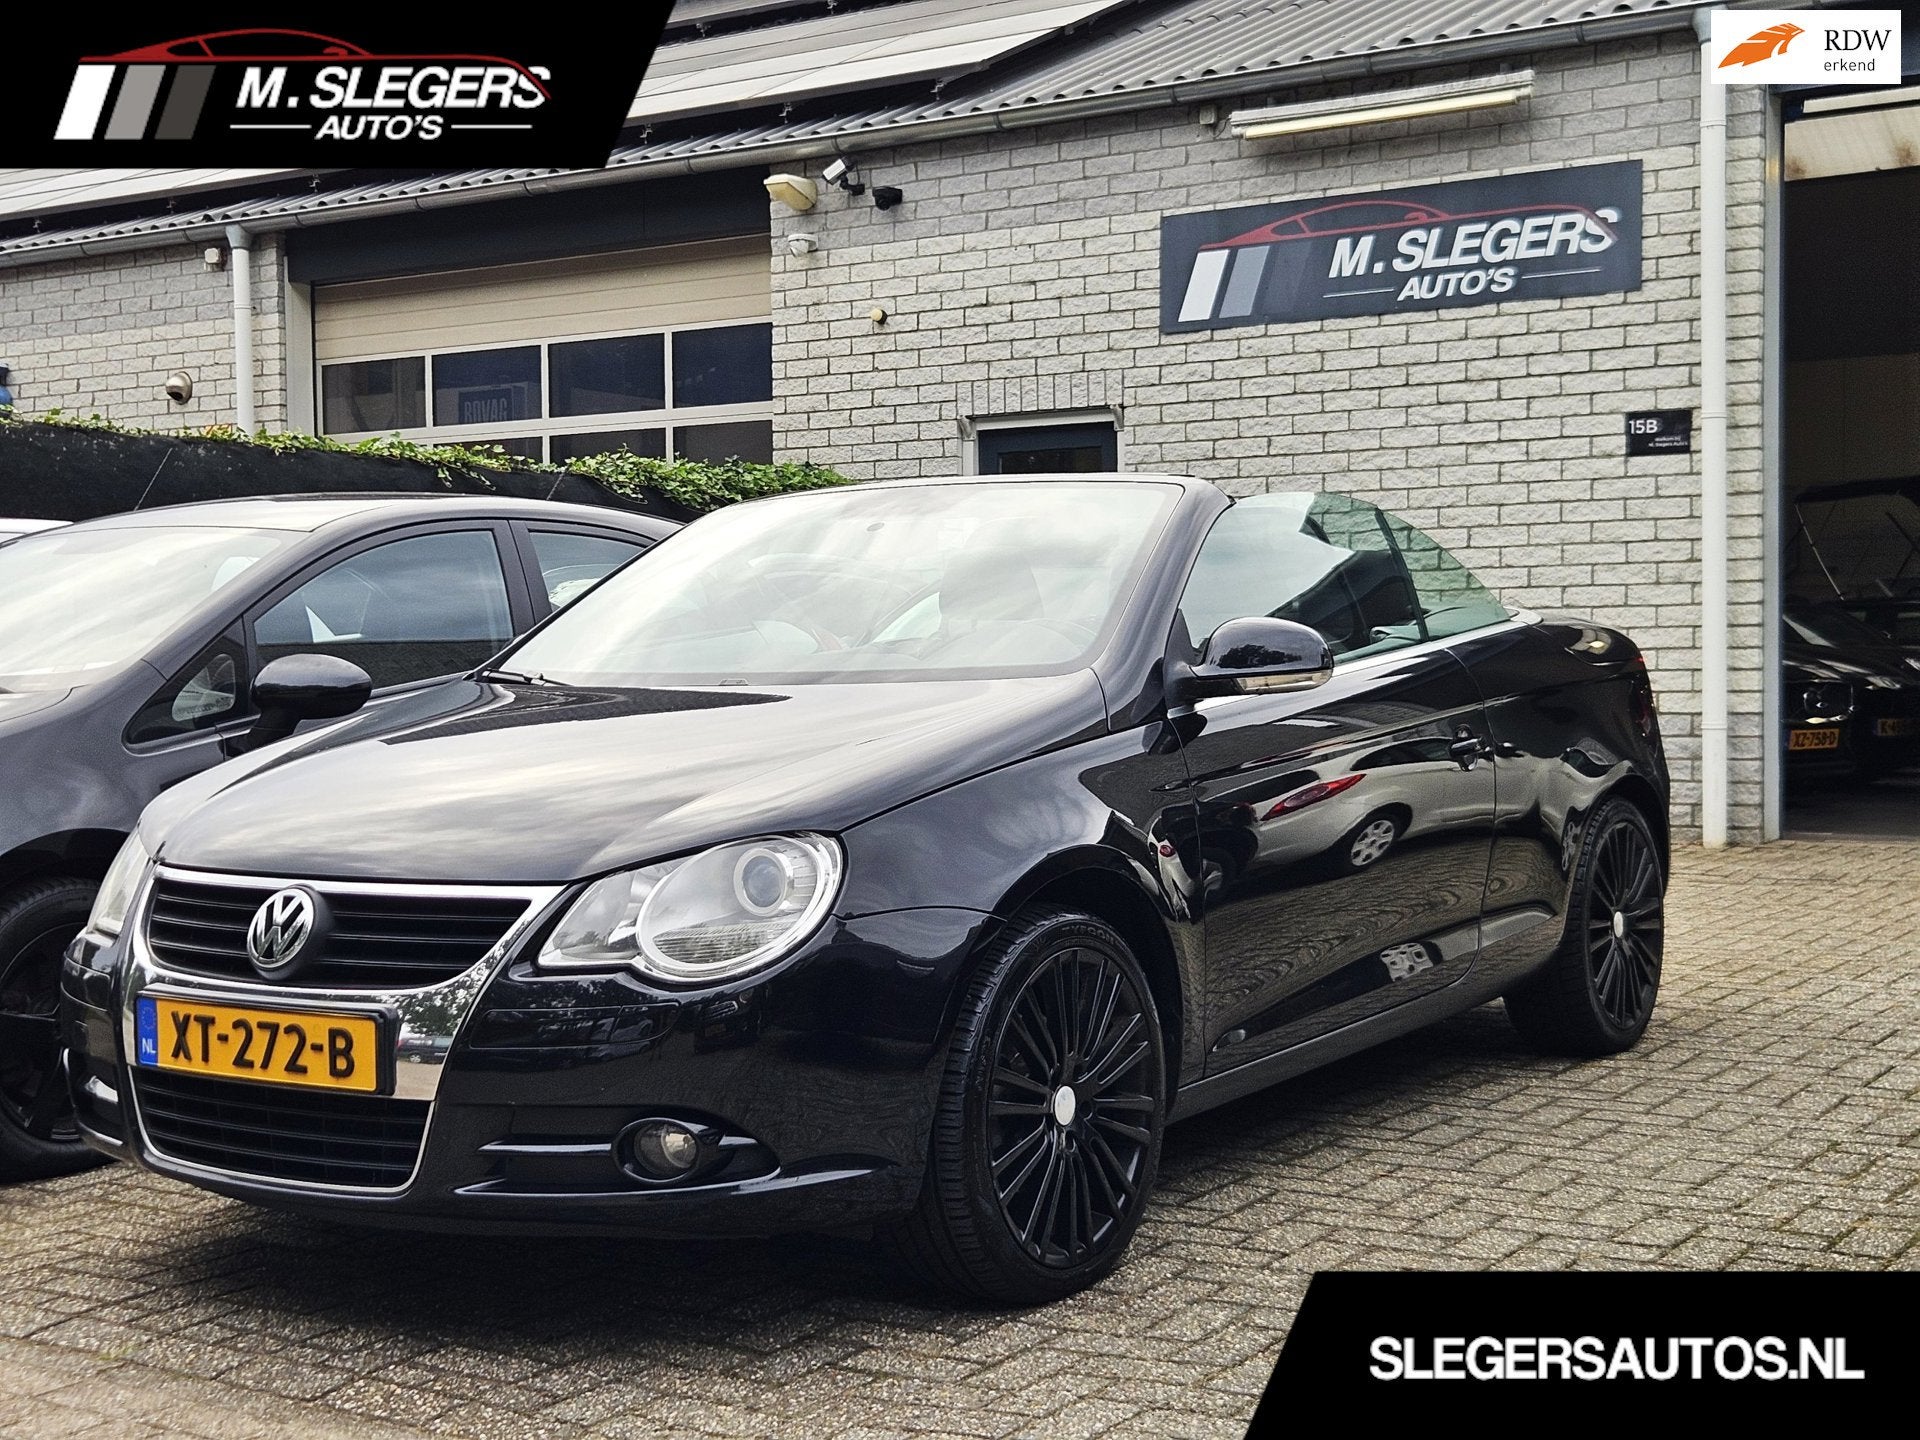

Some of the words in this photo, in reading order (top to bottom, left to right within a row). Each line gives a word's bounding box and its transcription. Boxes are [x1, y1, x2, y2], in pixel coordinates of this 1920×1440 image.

[1392, 207, 1620, 272] SLEGERS
[1397, 266, 1516, 301] AUTO'S
[1629, 419, 1658, 434] 15B
[142, 1037, 157, 1055] NL
[171, 1010, 355, 1079] XT-272-B
